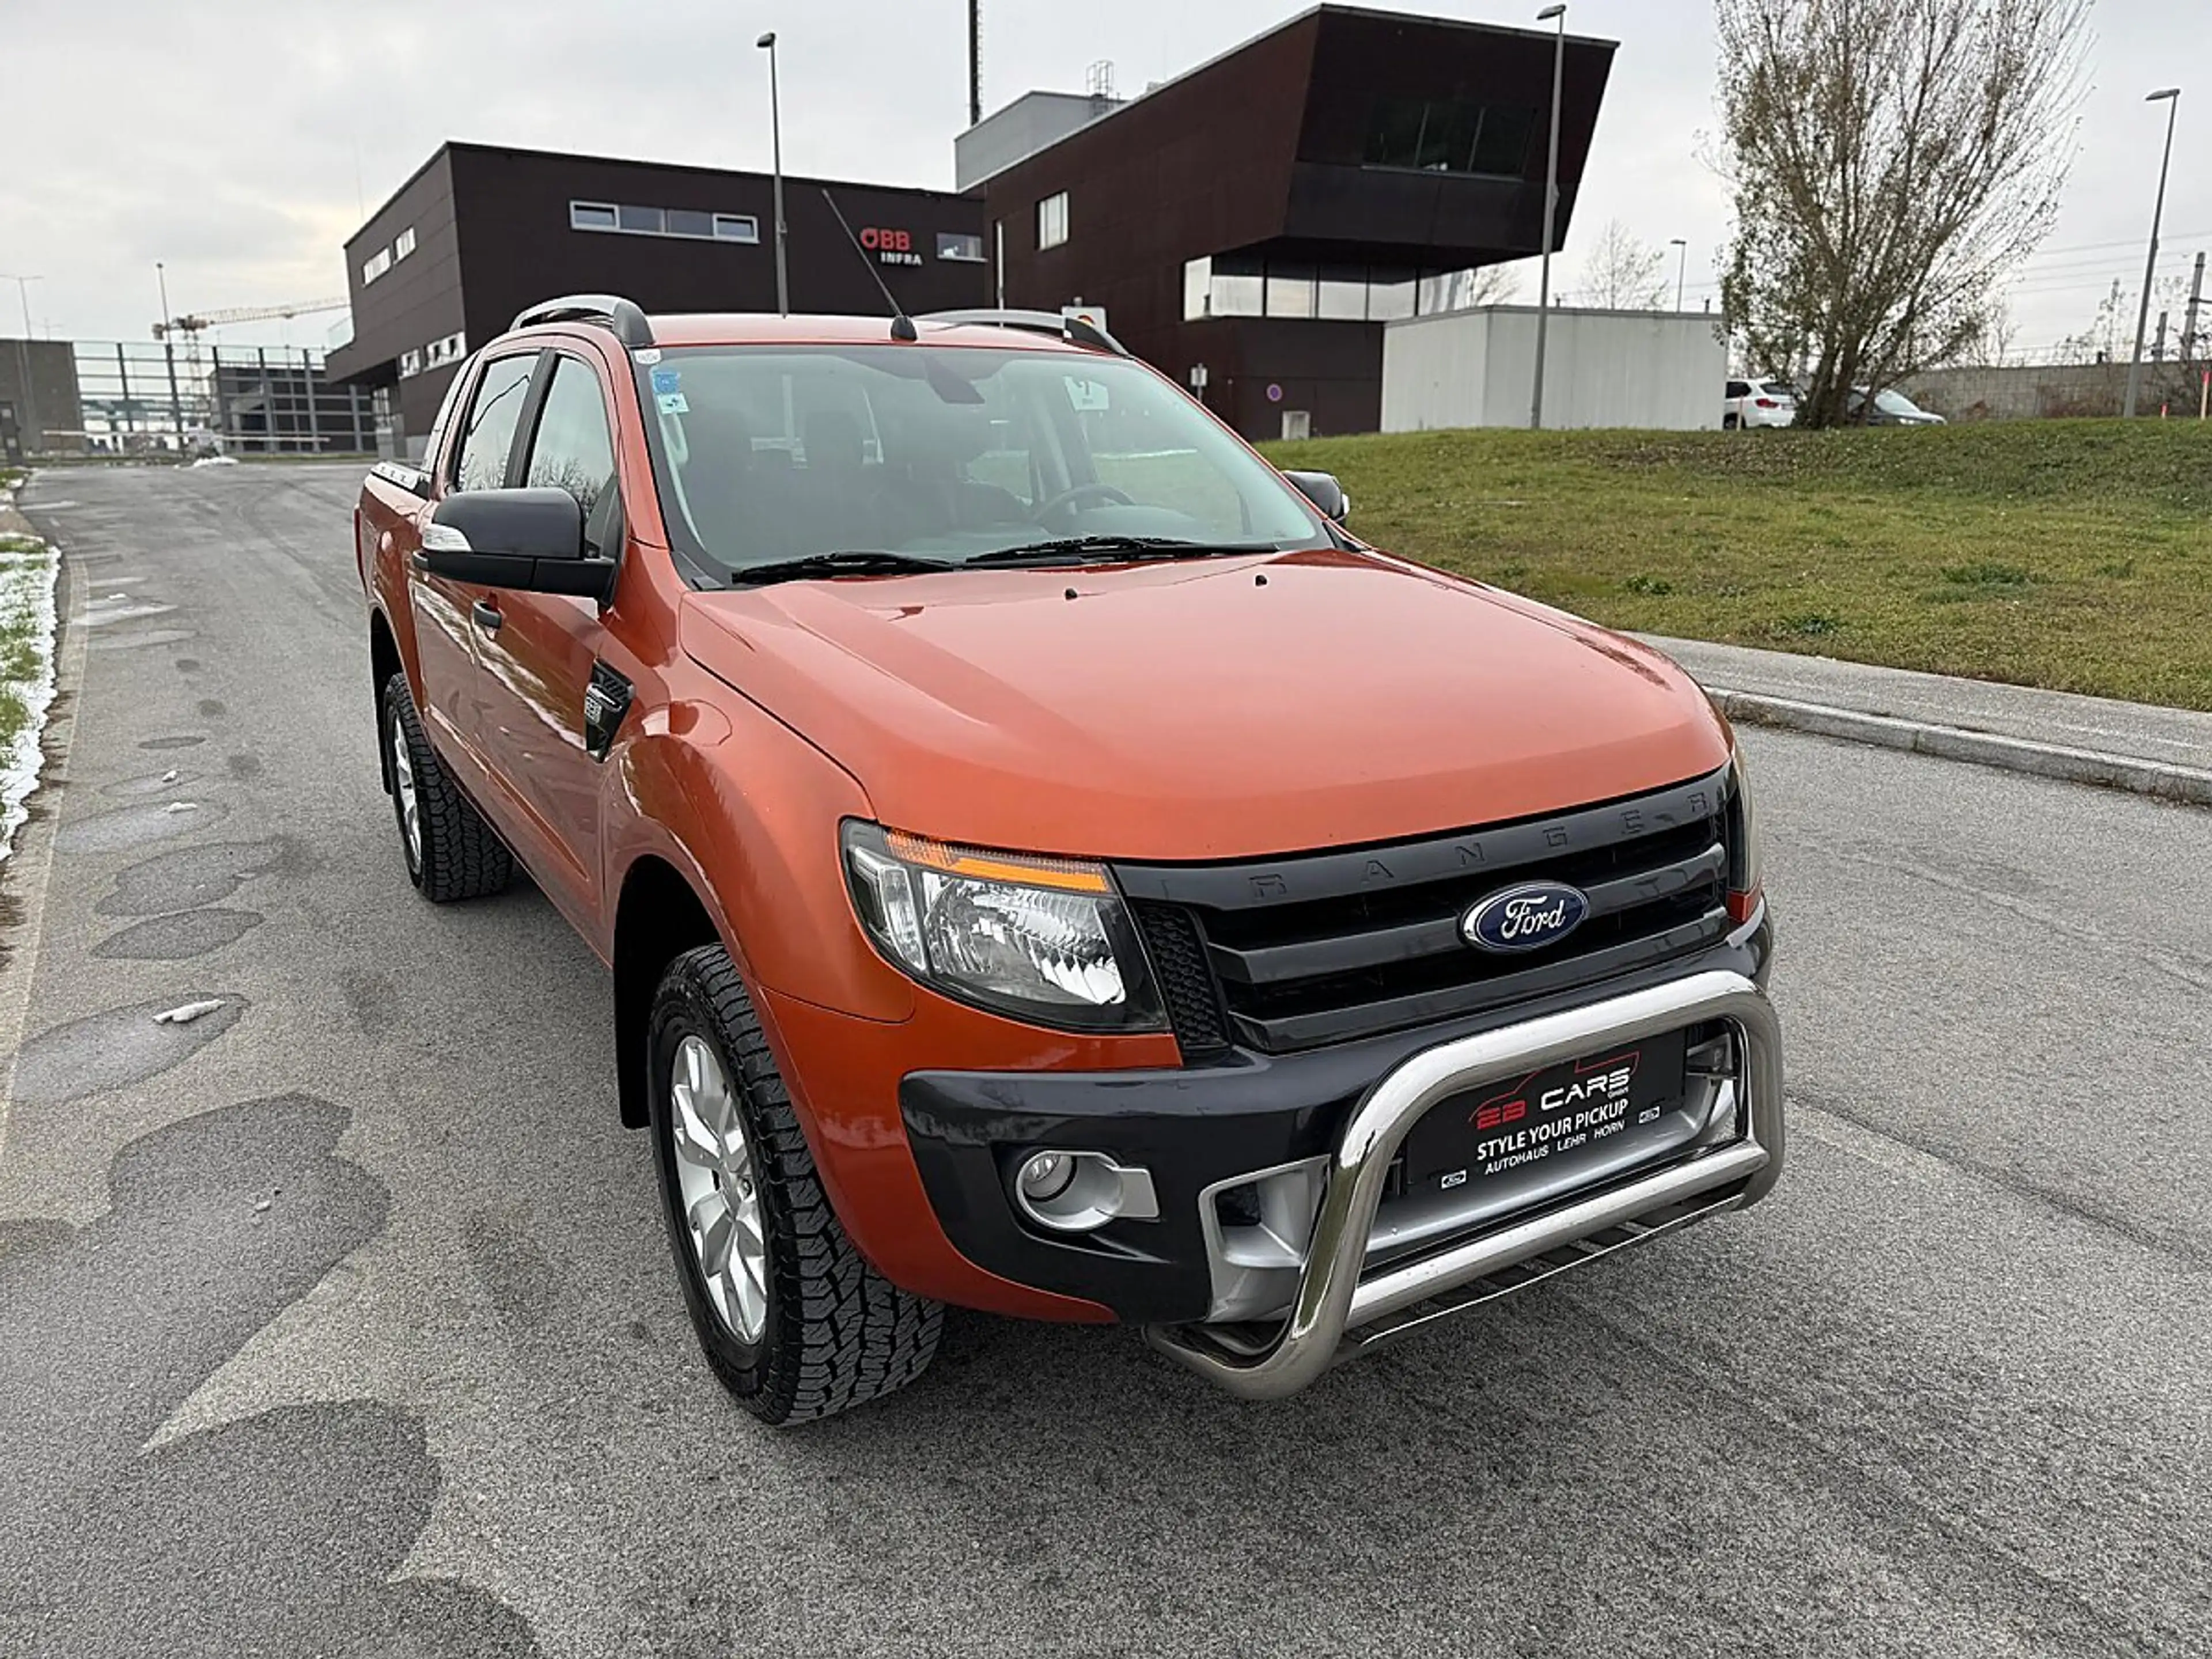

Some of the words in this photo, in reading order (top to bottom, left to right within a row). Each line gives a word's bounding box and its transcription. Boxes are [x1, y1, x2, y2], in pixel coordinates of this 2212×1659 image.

[880, 252, 922, 266] INFRA
[1248, 792, 1707, 898] RANGER
[1501, 895, 1566, 940] Ford
[1540, 1067, 1630, 1111] CARS
[1476, 1130, 1527, 1161] STYLE
[1528, 1116, 1572, 1144] YOUR
[1575, 1098, 1629, 1130] PICKUP
[1484, 1144, 1550, 1175] AUTOHAUS
[1557, 1133, 1586, 1152] LEHR
[1594, 1119, 1625, 1139] HORN
